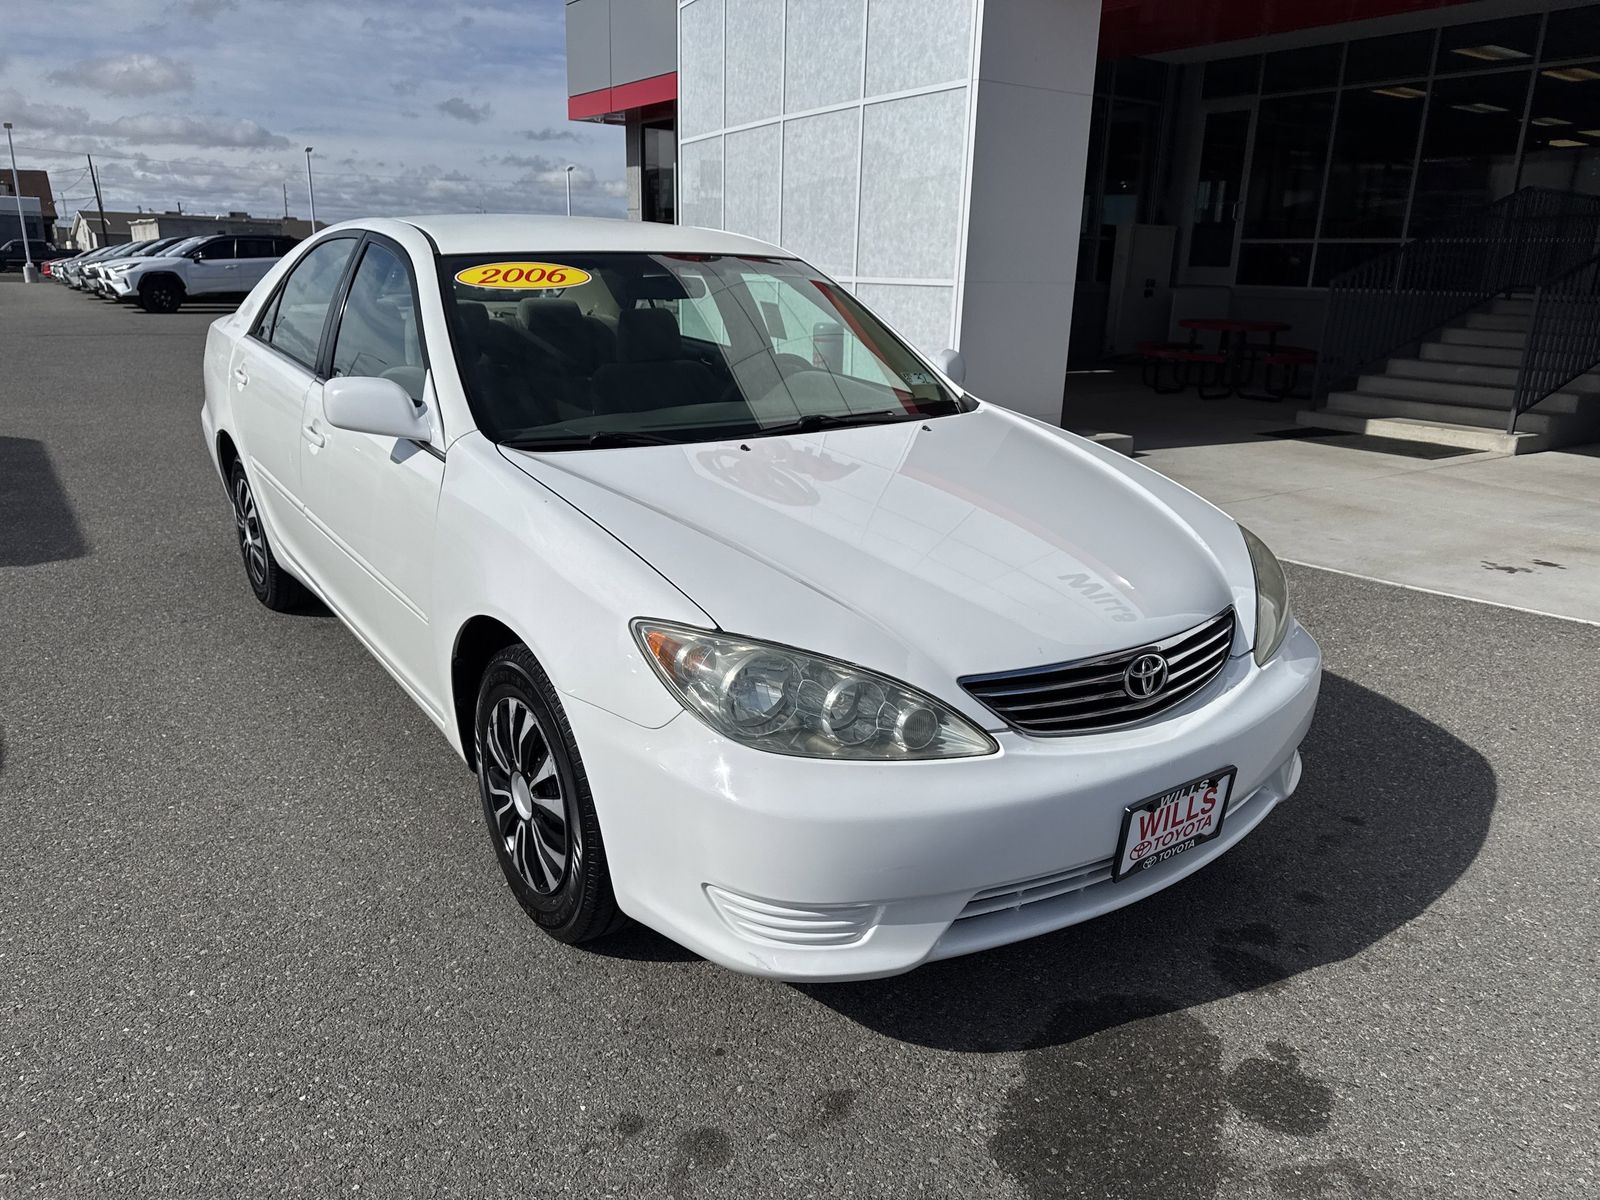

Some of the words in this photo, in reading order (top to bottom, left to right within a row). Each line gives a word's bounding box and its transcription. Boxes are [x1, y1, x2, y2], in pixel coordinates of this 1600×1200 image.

[478, 267, 569, 284] 2006
[1139, 787, 1218, 841] WILLS
[1153, 814, 1212, 851] TOYOTA
[1159, 839, 1195, 862] TOYOTA
